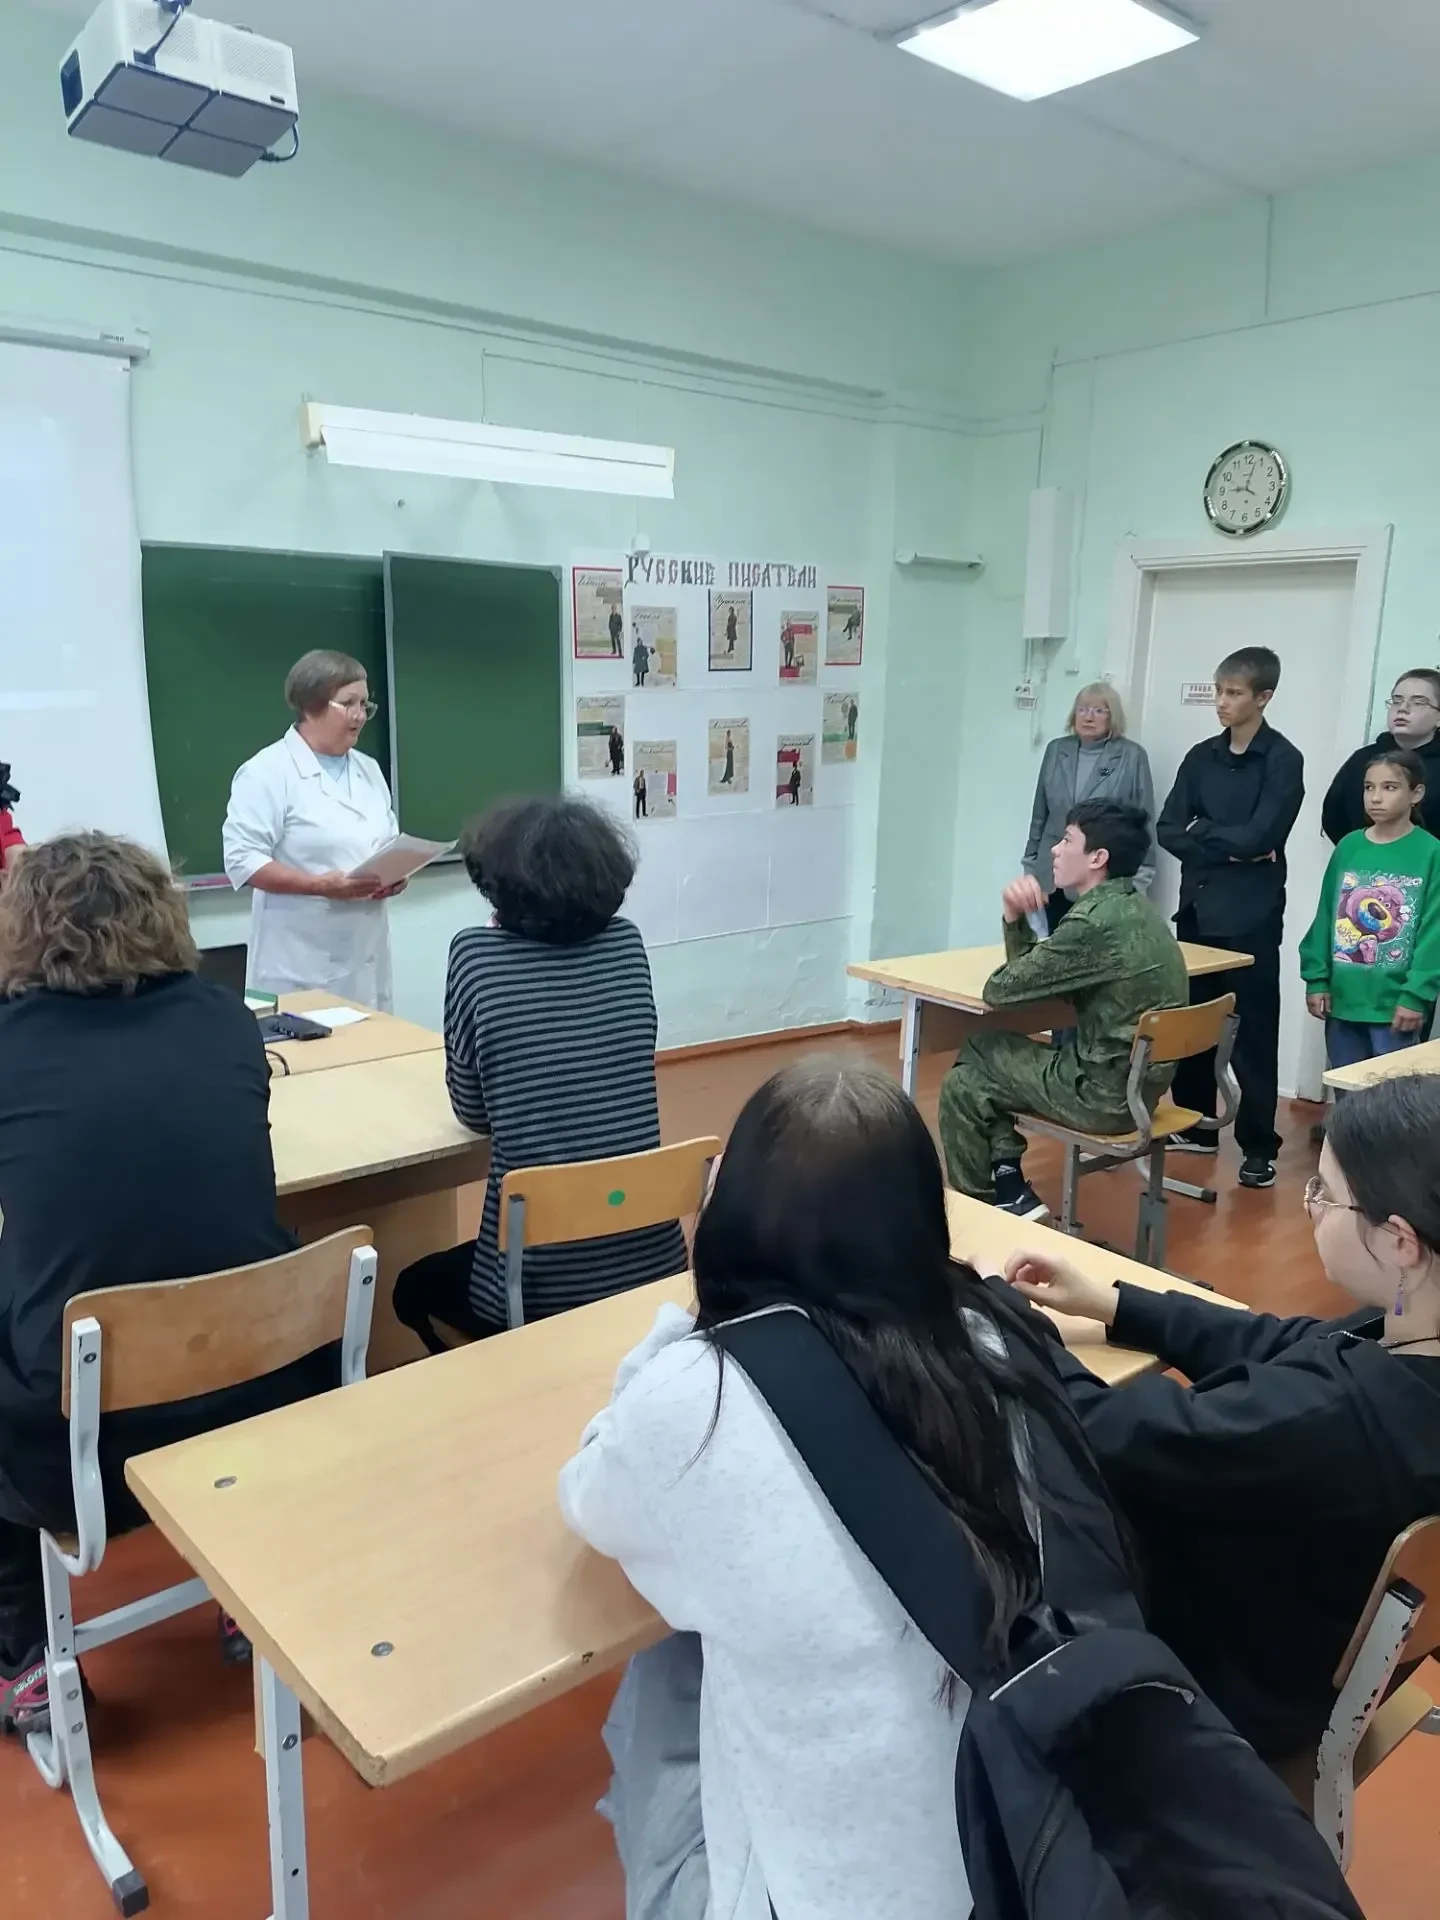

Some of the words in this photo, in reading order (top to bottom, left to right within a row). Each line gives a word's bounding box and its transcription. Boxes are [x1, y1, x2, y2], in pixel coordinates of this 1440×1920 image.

[1232, 460, 1241, 468] 11
[1244, 454, 1254, 464] 12
[1259, 457, 1264, 467] 1
[1222, 472, 1232, 481] 10
[1266, 467, 1273, 477] 2
[1269, 481, 1276, 491] 3
[1219, 487, 1226, 496] 9
[1221, 500, 1228, 510] 8
[1264, 496, 1271, 505] 4
[1229, 510, 1236, 520] 7
[1254, 507, 1261, 517] 5
[1241, 513, 1248, 522] 6
[625, 555, 715, 588] РУССКИЕ
[728, 562, 817, 588] ПИСАТЕЛИ
